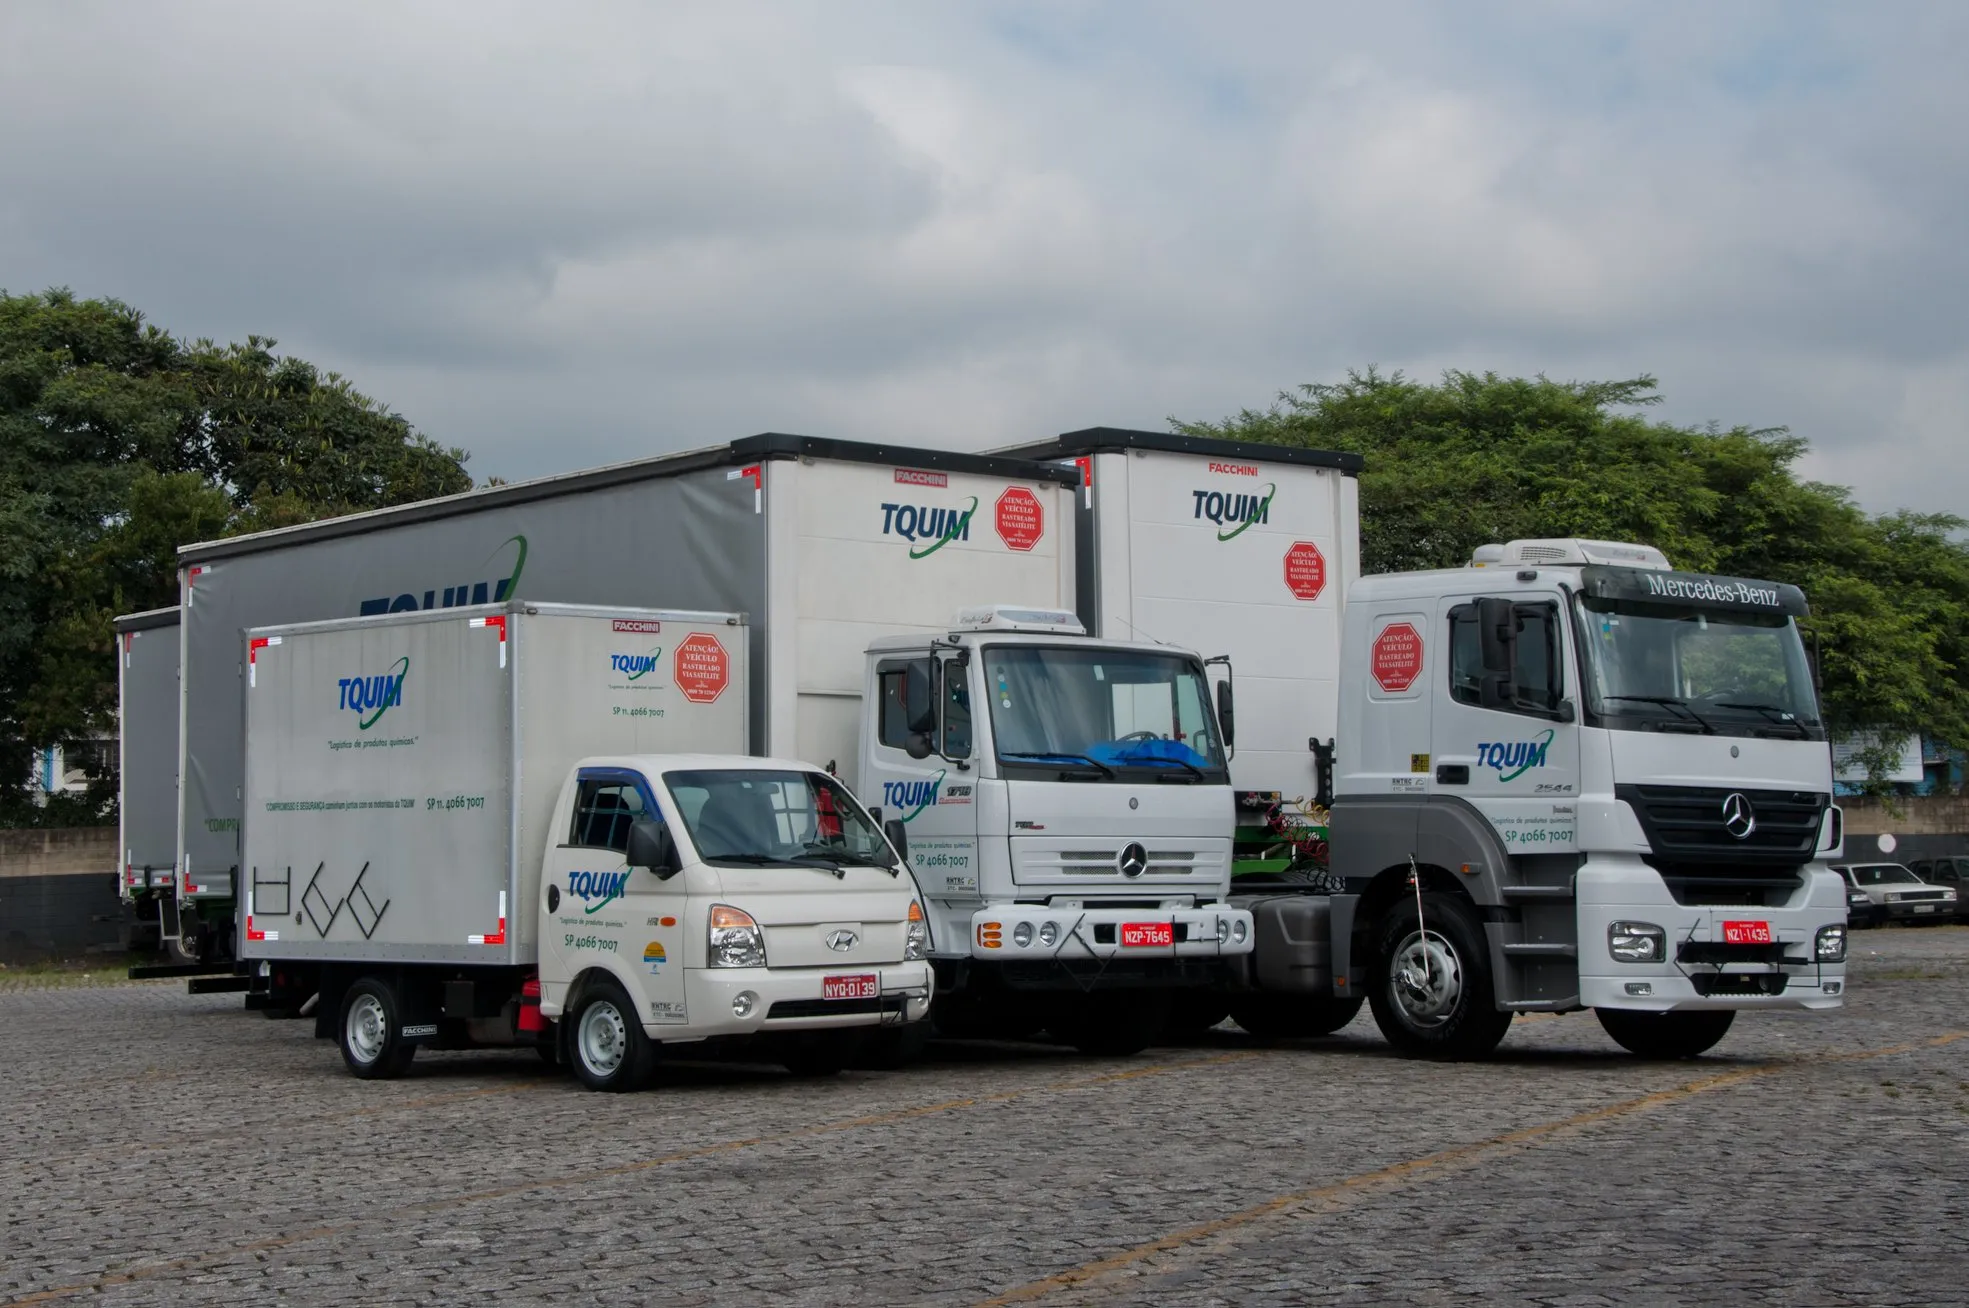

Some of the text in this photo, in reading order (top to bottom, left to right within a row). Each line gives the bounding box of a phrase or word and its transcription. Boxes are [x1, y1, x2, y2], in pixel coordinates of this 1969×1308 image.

[1209, 462, 1258, 476] FACCHINI
[896, 470, 947, 487] FACCHINI
[1004, 497, 1034, 506] ATENÇÃO!
[1193, 490, 1269, 526] TQUIM
[1005, 505, 1034, 514] VEÍCULO
[881, 503, 970, 542] TQUIM
[1002, 514, 1036, 522] RASTREADO
[1645, 574, 1780, 607] Mercedes-Benz
[614, 621, 659, 632] FACCHINI
[1382, 633, 1414, 642] ATENÇÃO!
[685, 644, 718, 653] ATENÇÃO!
[1383, 643, 1412, 651] VEÍCULO
[611, 655, 656, 673] TQUIM
[686, 653, 718, 662] VEÍCULO
[682, 662, 720, 671] RASTREADO
[338, 674, 403, 714] TQUIM
[613, 706, 620, 715] SP
[630, 707, 648, 716] 4066
[1478, 743, 1546, 771] TQUIM
[1534, 784, 1572, 792] 2544
[884, 782, 938, 810] TQUIM
[427, 798, 435, 810] SP
[446, 796, 465, 812] 4066
[466, 797, 485, 810] 7007
[1505, 829, 1573, 844] SP 4066 7007
[916, 853, 968, 868] SP 4066 7007
[569, 871, 625, 901] TQUIM
[565, 934, 618, 953] SP 4066 7007
